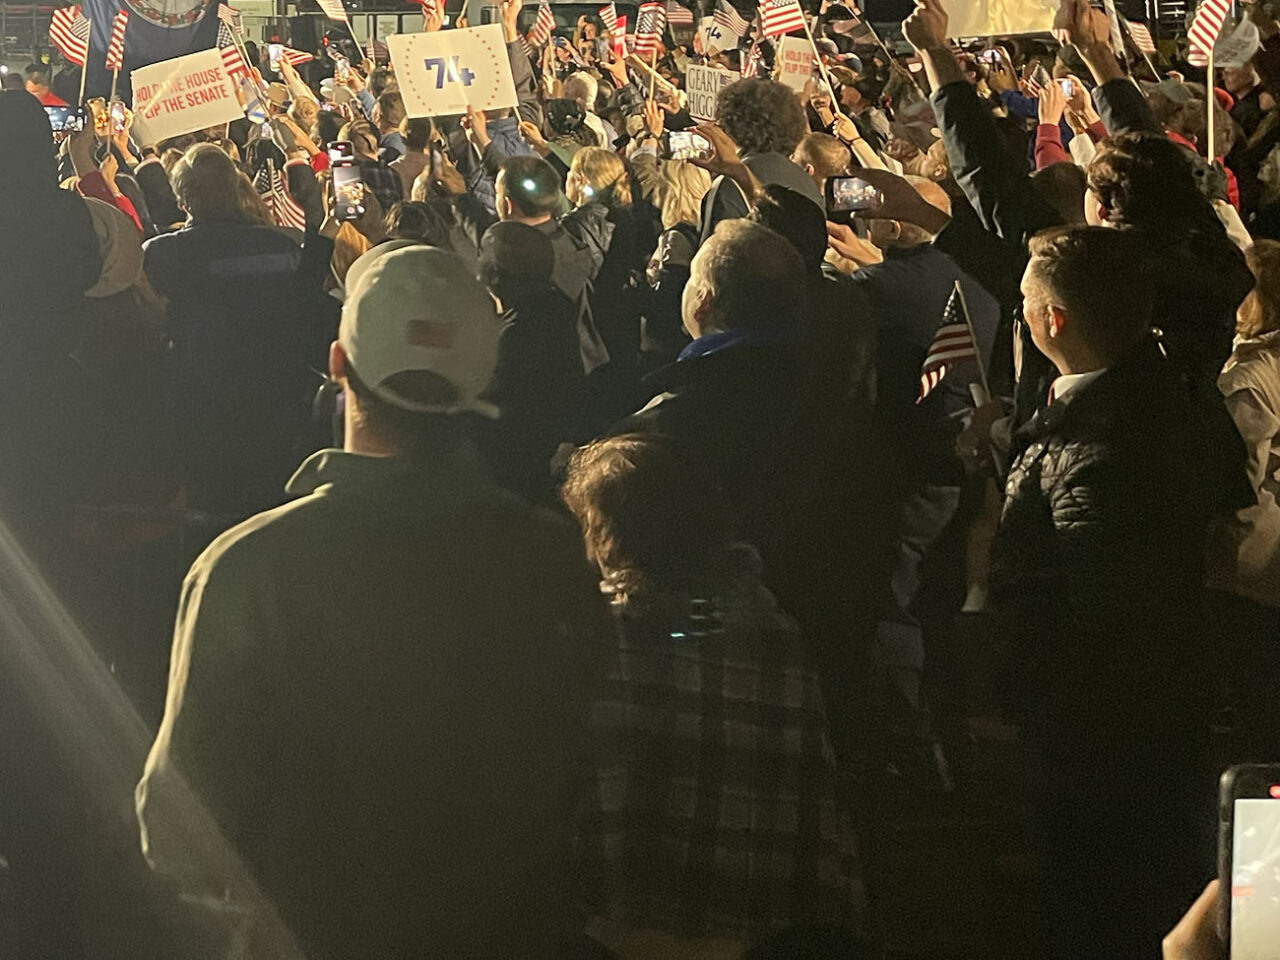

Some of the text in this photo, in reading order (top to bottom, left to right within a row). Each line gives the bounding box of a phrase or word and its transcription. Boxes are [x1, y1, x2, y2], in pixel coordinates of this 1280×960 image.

[185, 67, 223, 89] HOUSE
[424, 55, 476, 89] 74
[688, 67, 719, 93] GEARY
[163, 95, 186, 113] THE
[185, 84, 229, 107] SENATE
